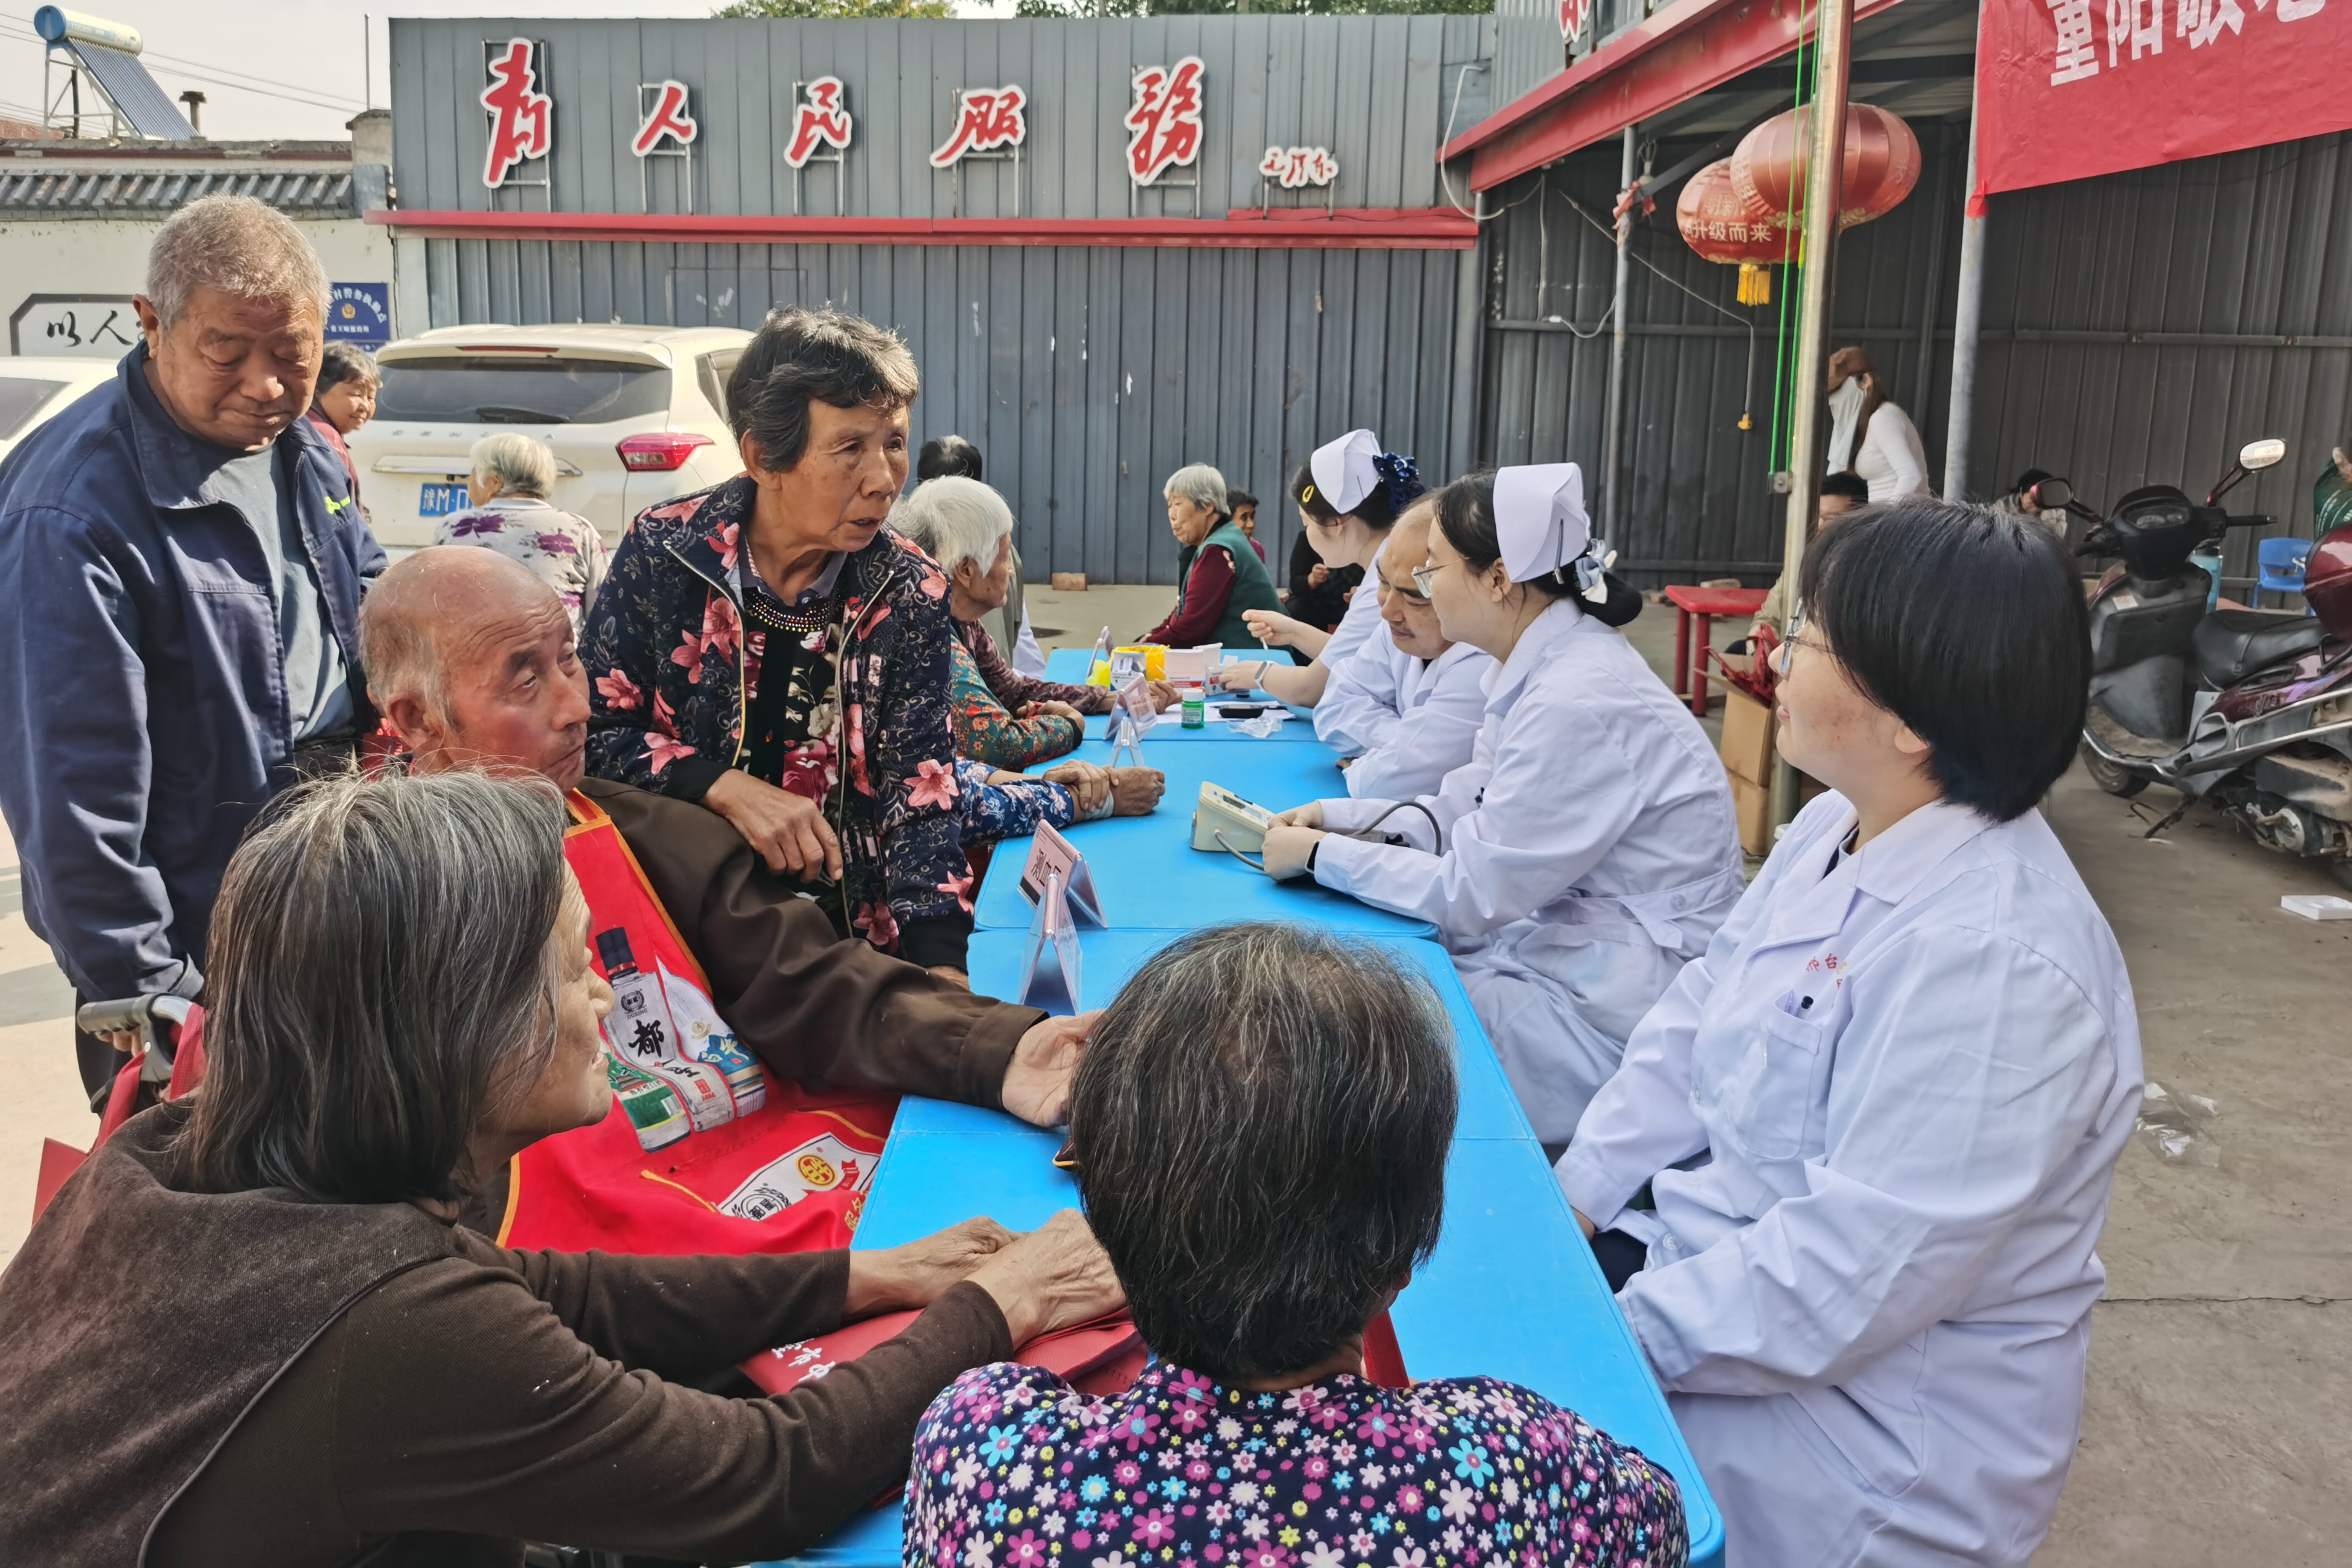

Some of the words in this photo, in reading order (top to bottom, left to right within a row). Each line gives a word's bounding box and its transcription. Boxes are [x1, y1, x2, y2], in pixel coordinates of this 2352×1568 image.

[47, 309, 147, 348] 以人
[627, 1008, 648, 1019] DUXING
[628, 1019, 665, 1058] 都
